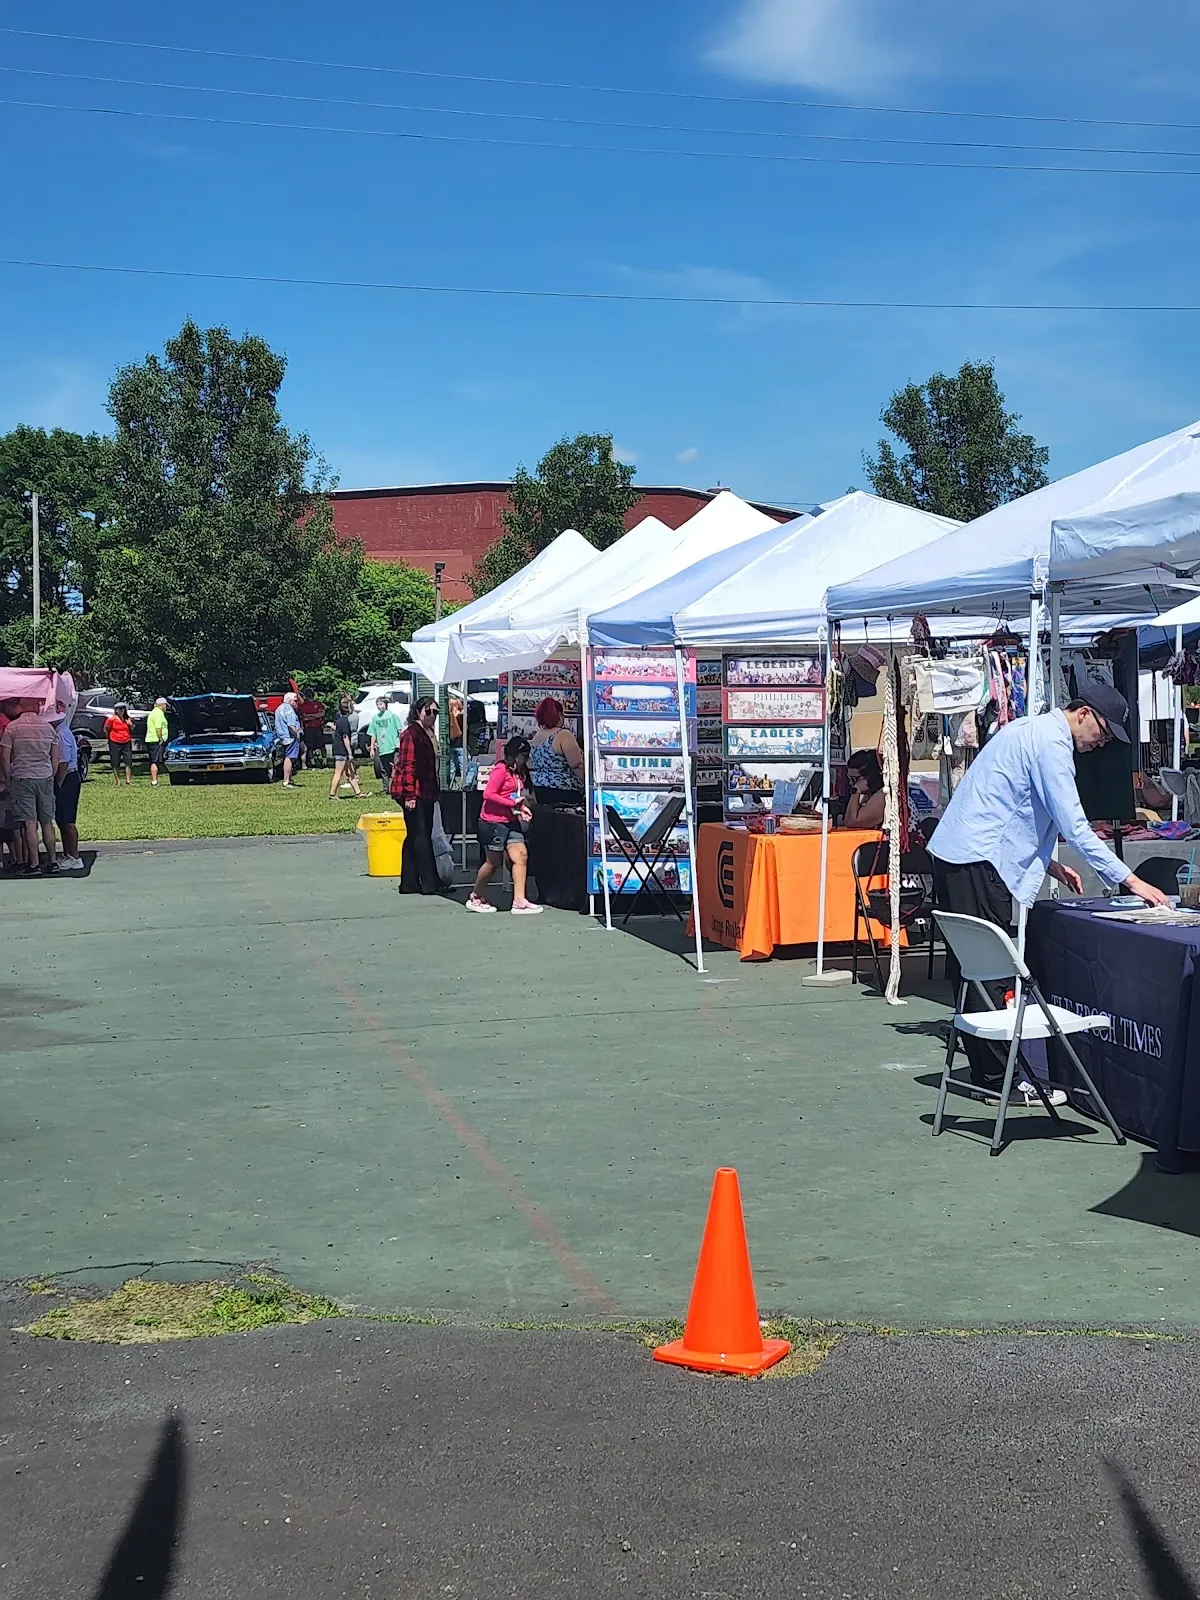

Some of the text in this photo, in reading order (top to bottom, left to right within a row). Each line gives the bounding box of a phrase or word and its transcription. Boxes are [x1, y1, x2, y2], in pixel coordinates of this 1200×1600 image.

[746, 660, 805, 669] LEGENDS
[522, 689, 561, 698] JOSHUA
[753, 693, 803, 701] PHILLIES
[750, 729, 804, 738] EAGLES
[617, 757, 672, 768] QUINN
[1119, 1016, 1162, 1059] TIMES
